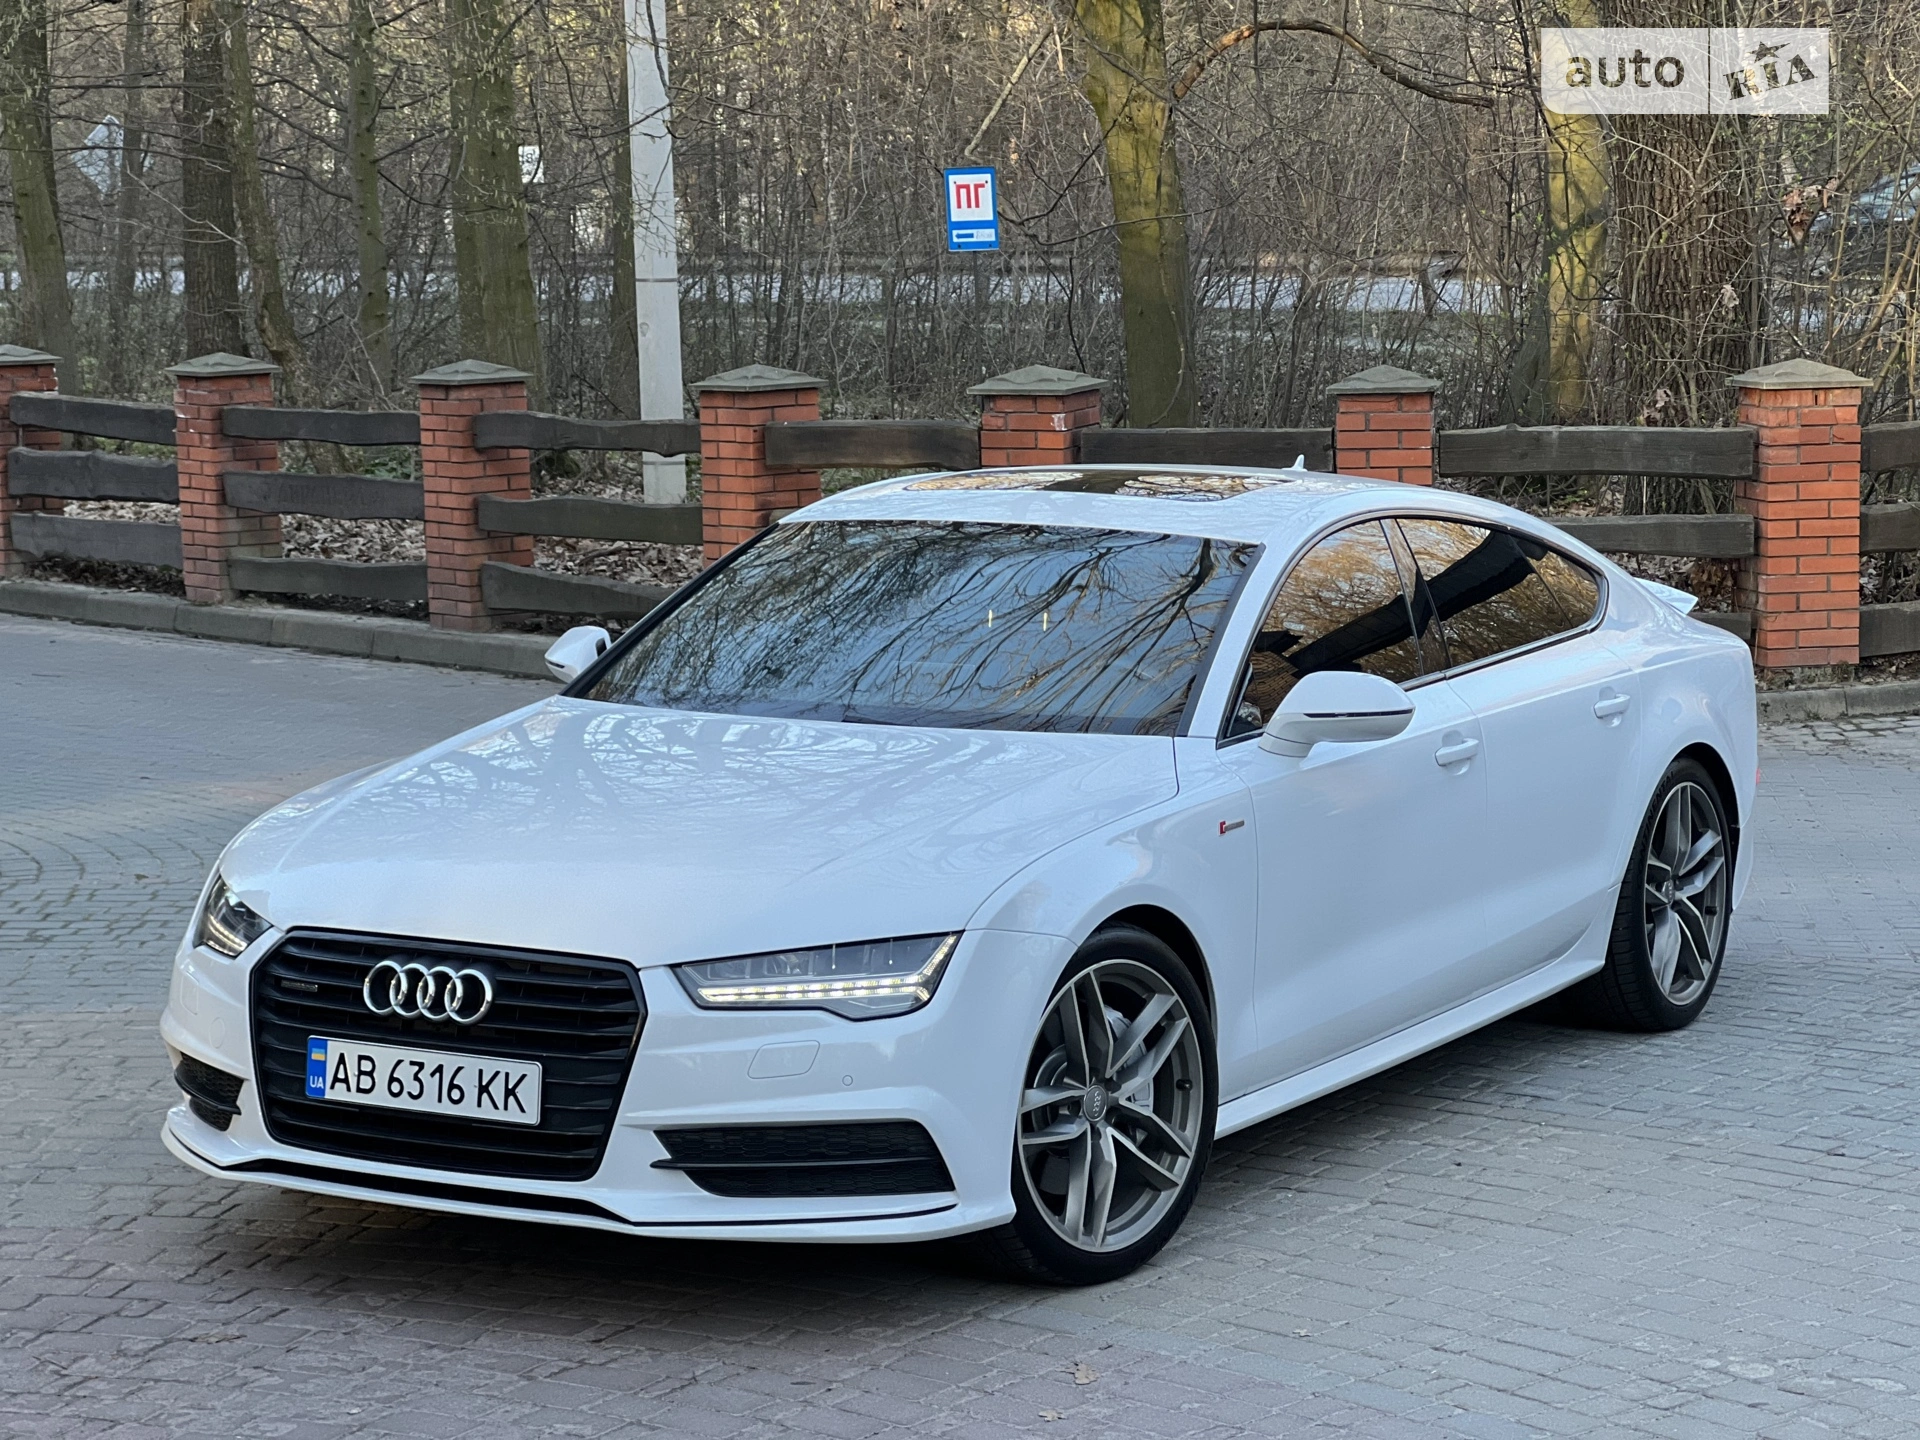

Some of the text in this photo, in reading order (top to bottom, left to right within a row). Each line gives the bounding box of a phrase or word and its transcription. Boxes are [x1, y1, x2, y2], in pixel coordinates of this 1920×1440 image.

[955, 183, 986, 210] ПГ
[309, 1075, 324, 1090] UA
[329, 1052, 528, 1114] AB 6316 KK
